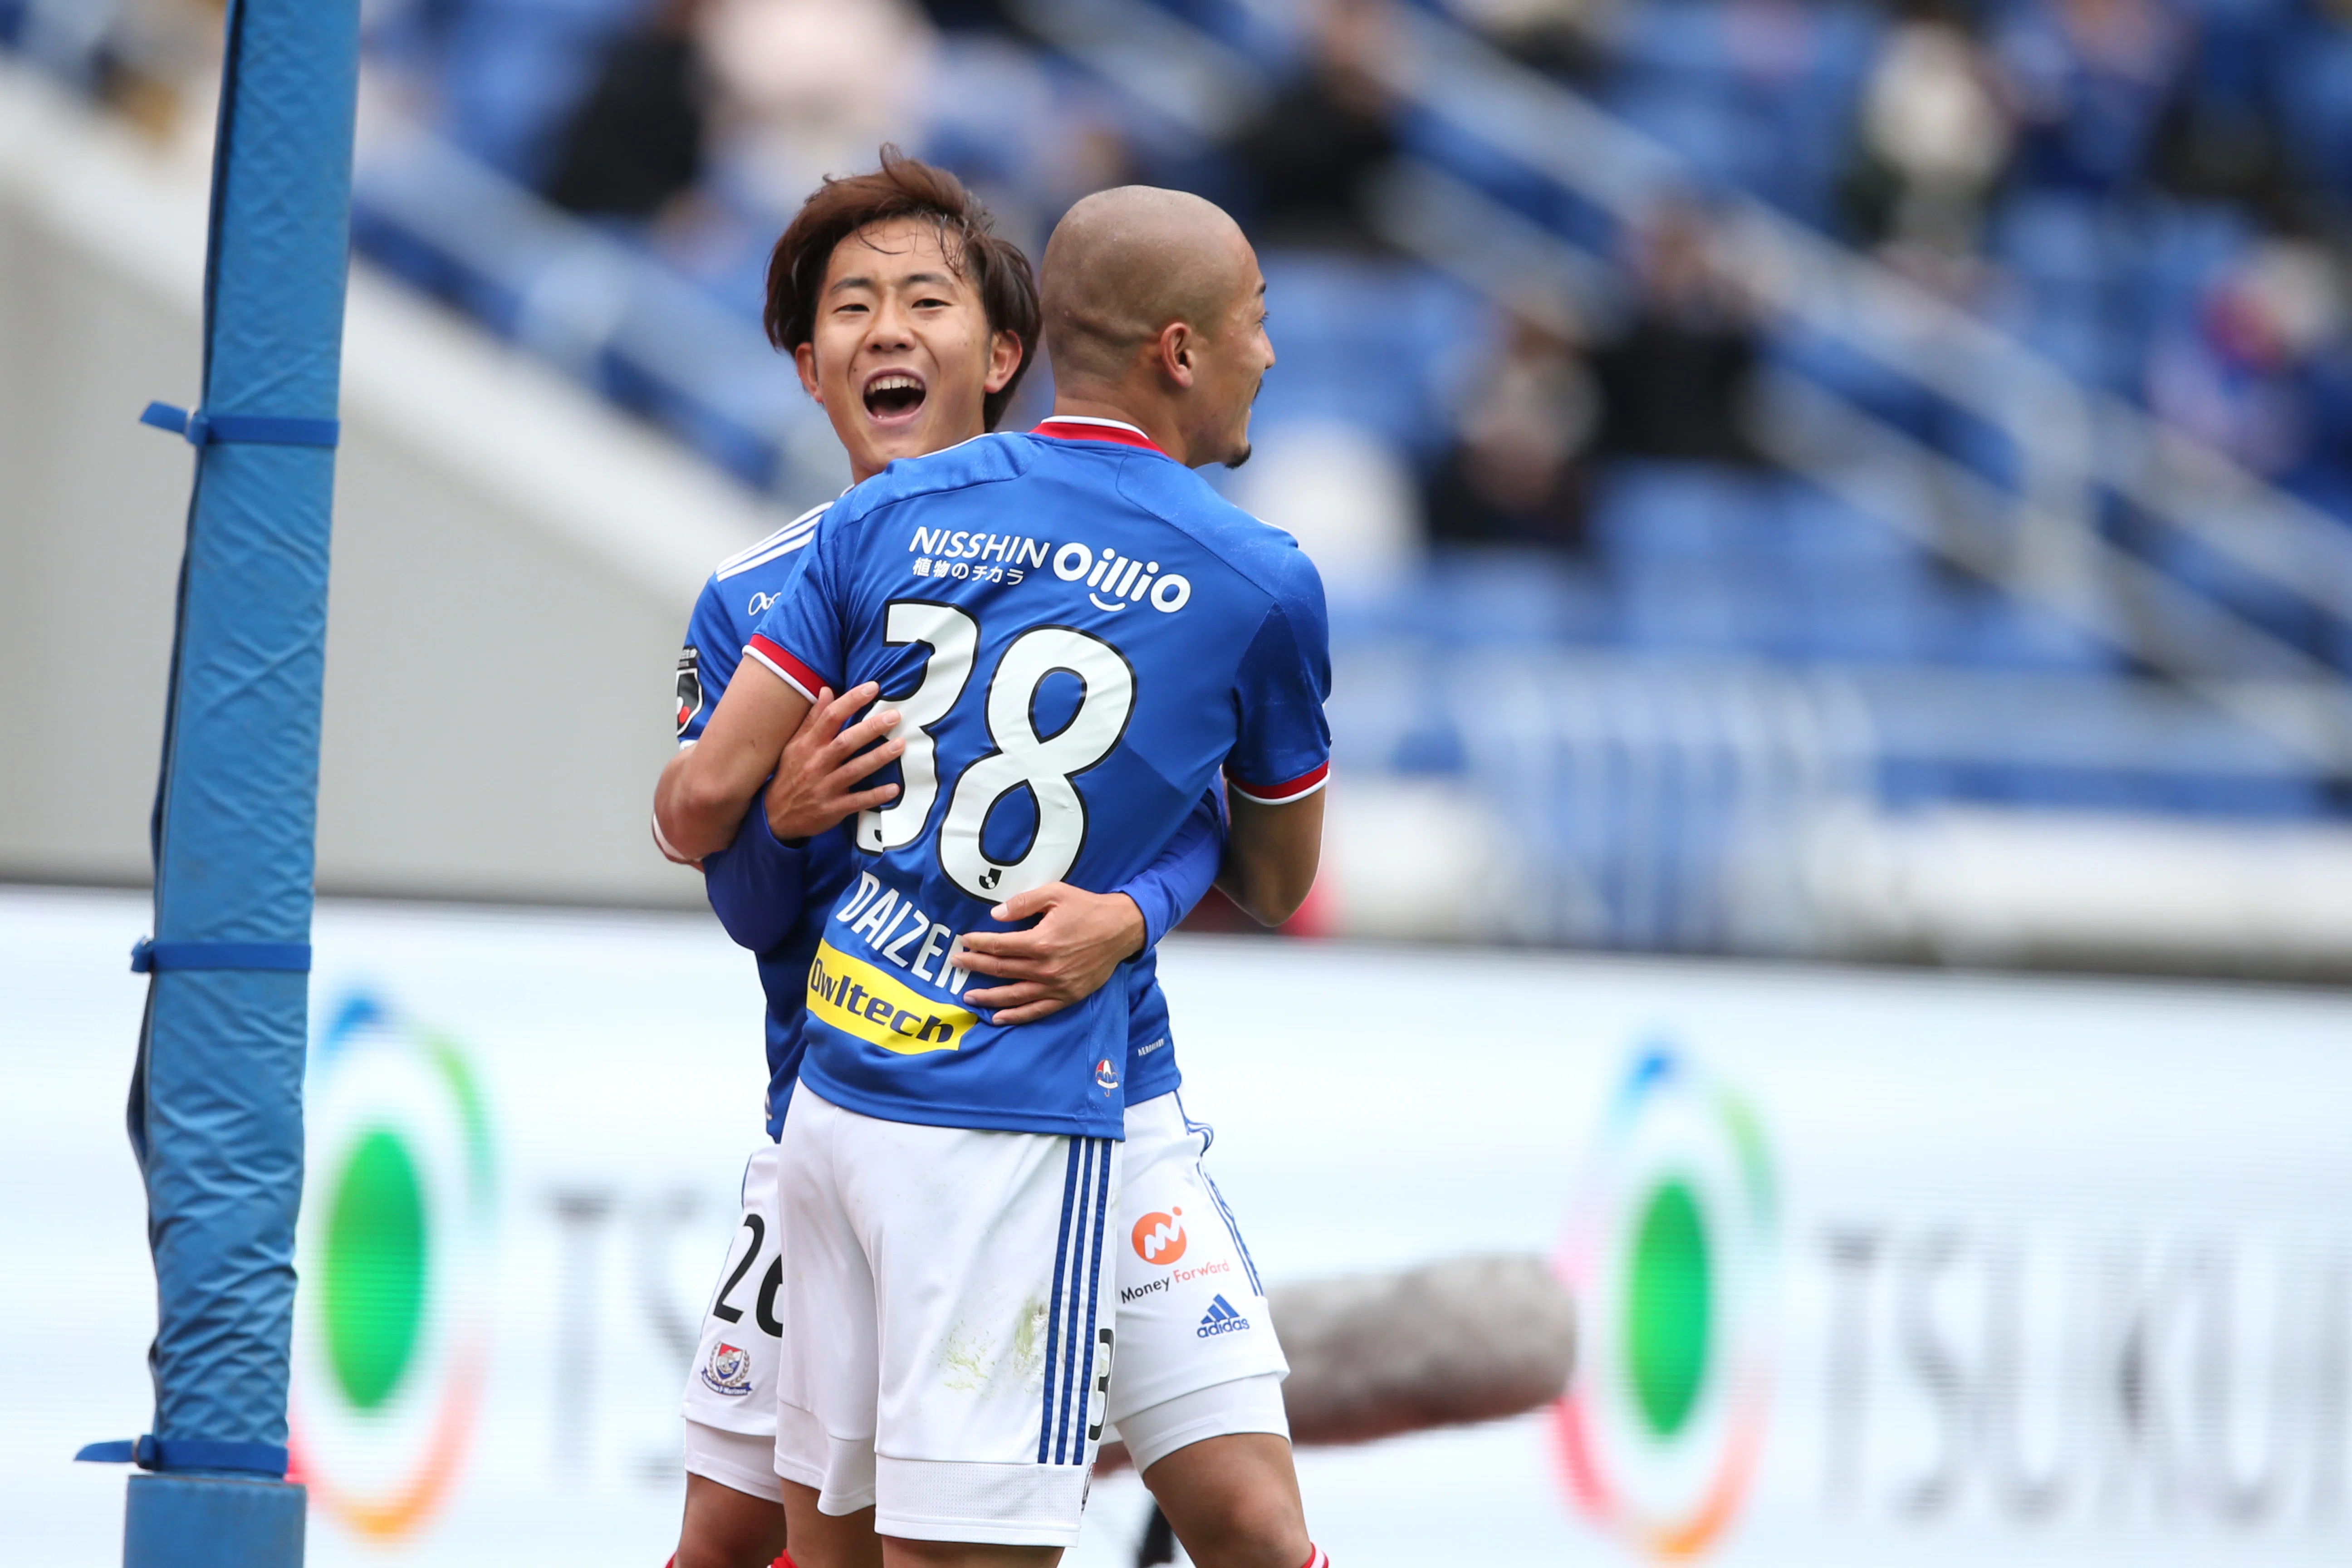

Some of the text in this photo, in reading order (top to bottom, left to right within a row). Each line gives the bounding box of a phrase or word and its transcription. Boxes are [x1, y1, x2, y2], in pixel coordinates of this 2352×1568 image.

[908, 525, 1192, 613] NISSHIN Oillio
[912, 556, 1024, 586] 植物のチカラ
[856, 598, 1137, 907] 38
[835, 870, 973, 995] DAIZEN
[810, 957, 954, 1043] Owltech
[1120, 1259, 1230, 1304] Money Forward
[1196, 1318, 1250, 1338] adidas
[1088, 1328, 1115, 1441] 3
